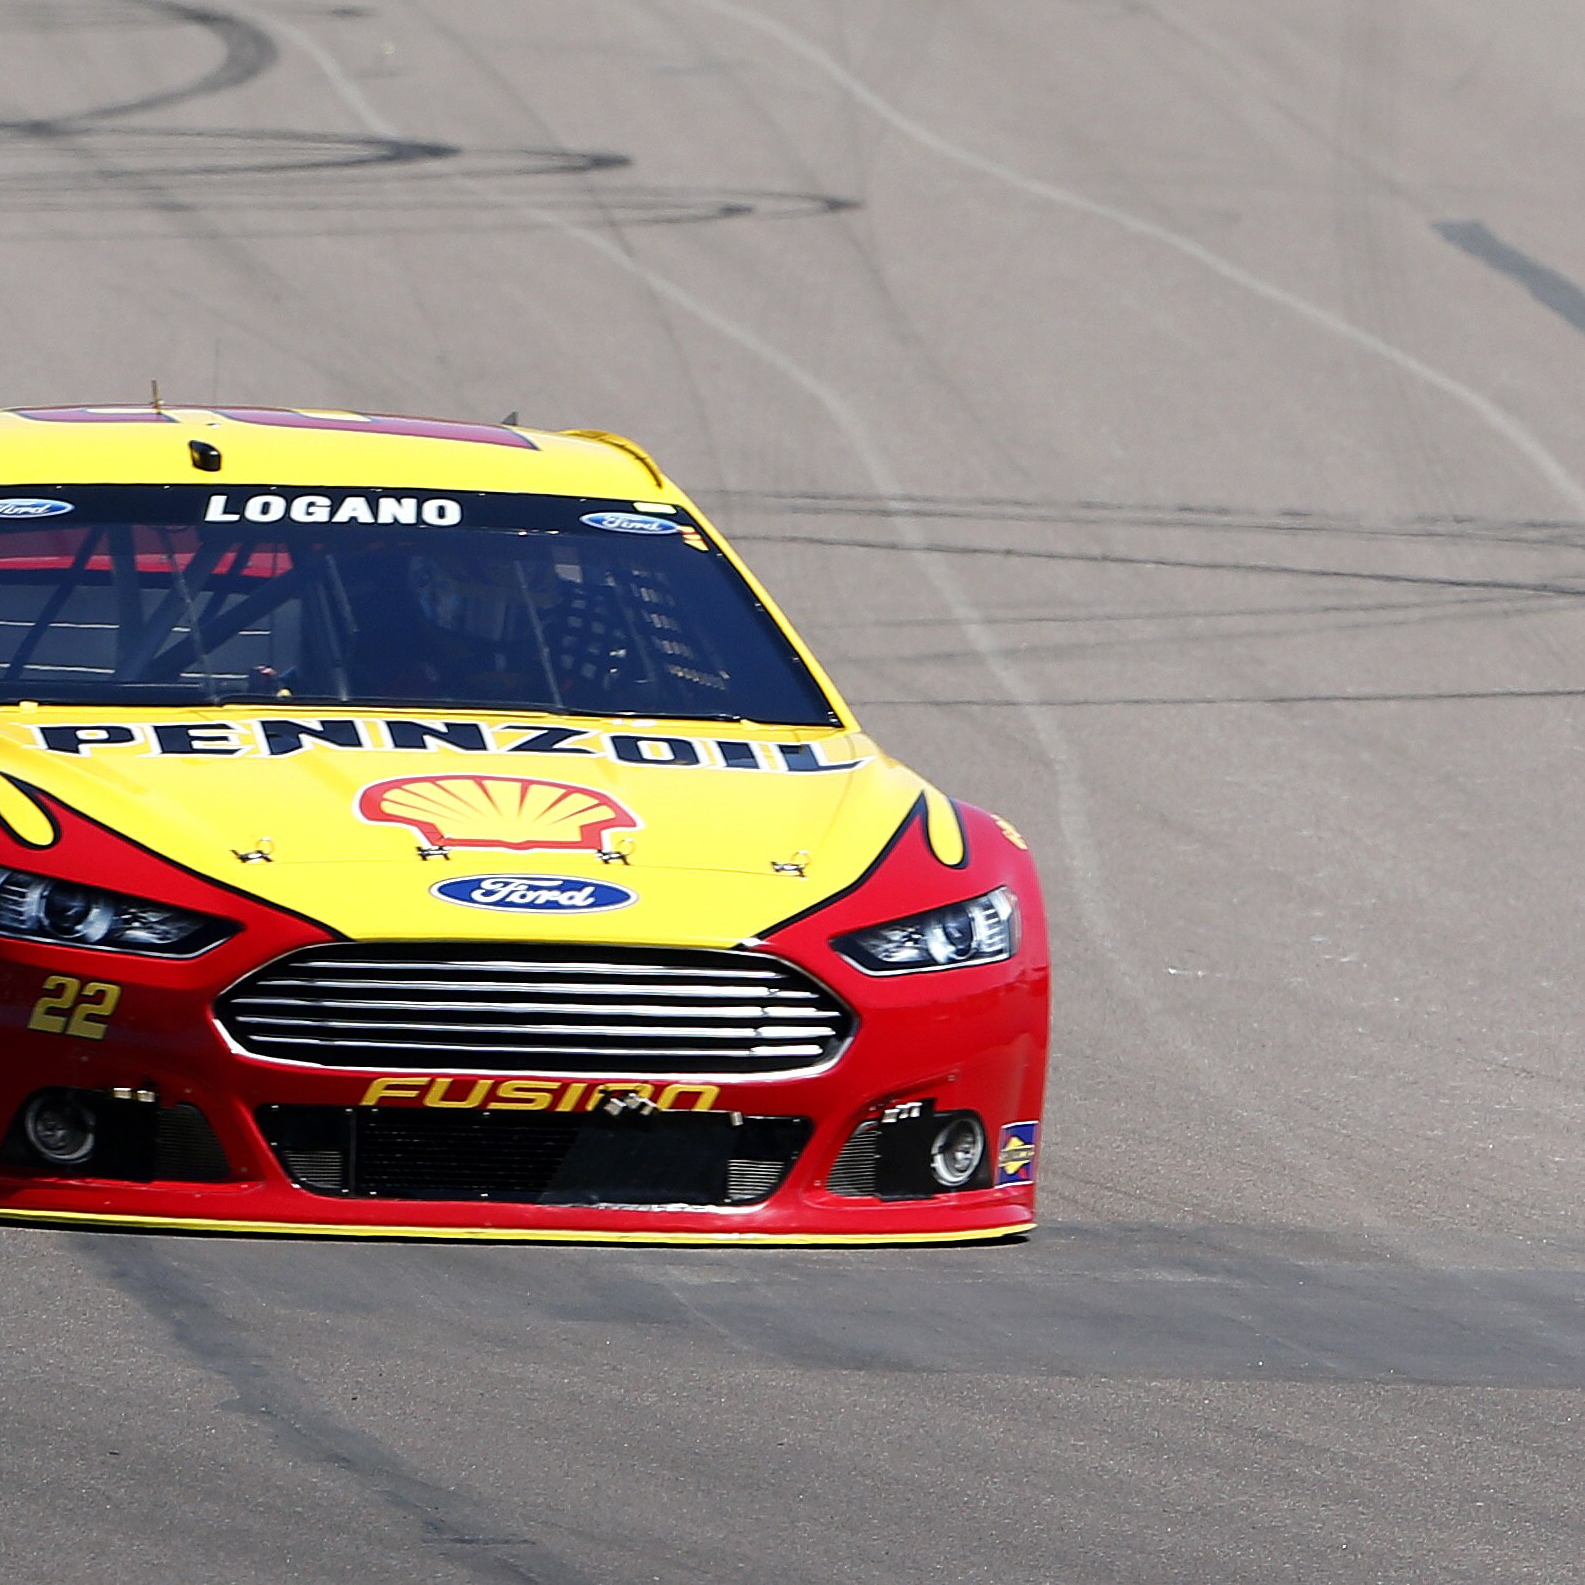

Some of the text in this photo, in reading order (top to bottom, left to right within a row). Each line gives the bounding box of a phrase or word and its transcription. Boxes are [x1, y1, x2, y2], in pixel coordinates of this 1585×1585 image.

[203, 493, 464, 528] LOGANO
[23, 718, 877, 774] PENNZOIL
[26, 974, 123, 1041] 22
[357, 1076, 722, 1114] FUSION
